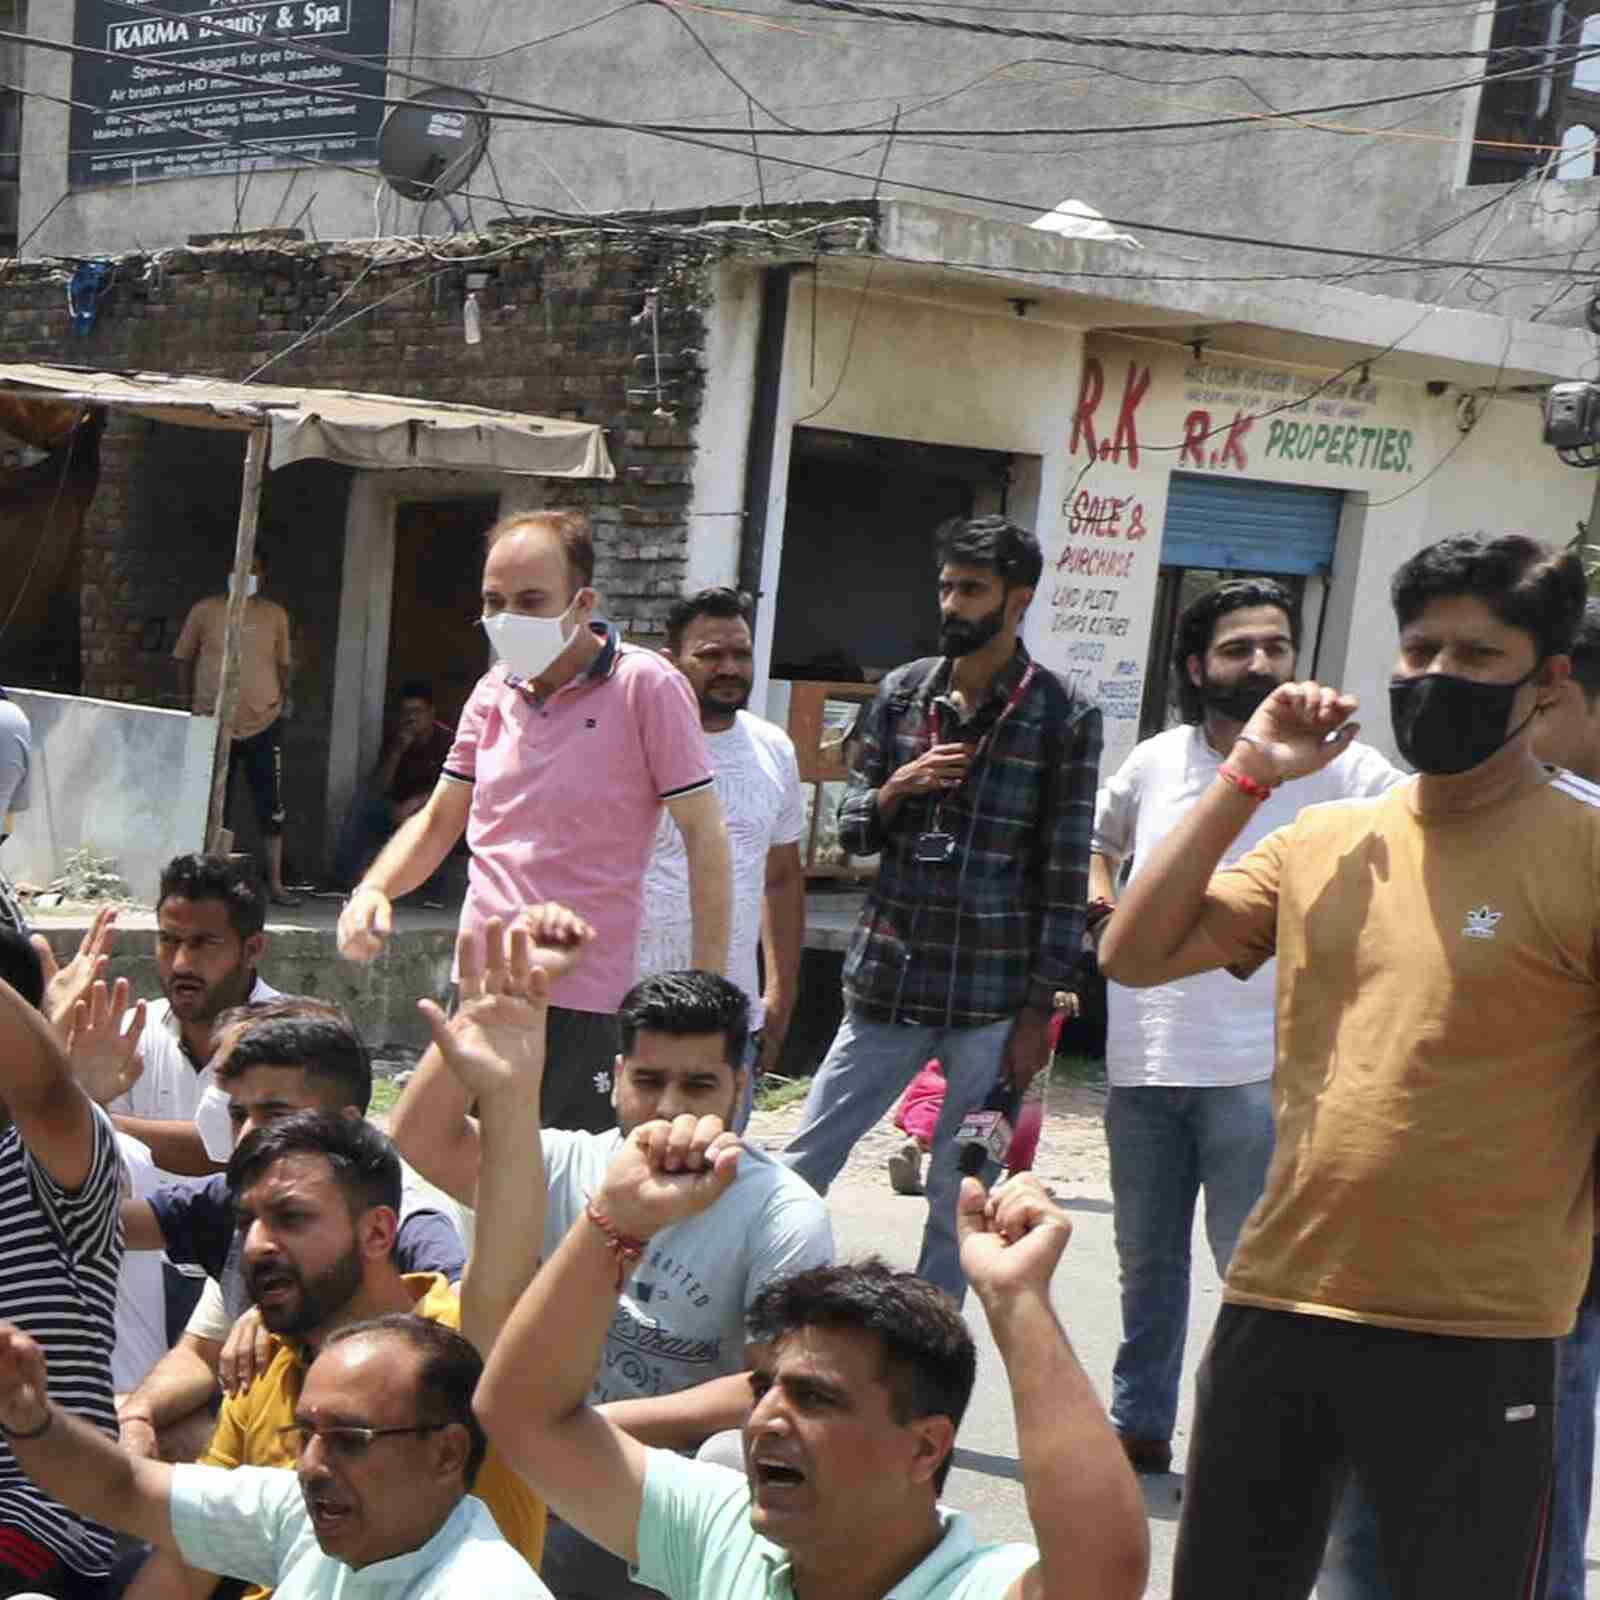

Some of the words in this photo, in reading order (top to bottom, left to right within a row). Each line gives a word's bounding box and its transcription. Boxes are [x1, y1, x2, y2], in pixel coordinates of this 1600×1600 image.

[114, 20, 189, 50] KARMA
[276, 6, 294, 28] &
[303, 2, 341, 32] Spa
[240, 51, 258, 66] for
[260, 51, 281, 66] pre
[110, 89, 127, 102] Air
[128, 84, 160, 100] brush
[163, 81, 185, 95] and
[188, 77, 208, 92] HD
[287, 65, 342, 81] available
[1070, 357, 1151, 470] R.K
[1264, 418, 1413, 473] PROPERTIES.
[1126, 502, 1147, 541] &
[1056, 545, 1135, 578] PURCHASE
[650, 1249, 712, 1308] RAFTED
